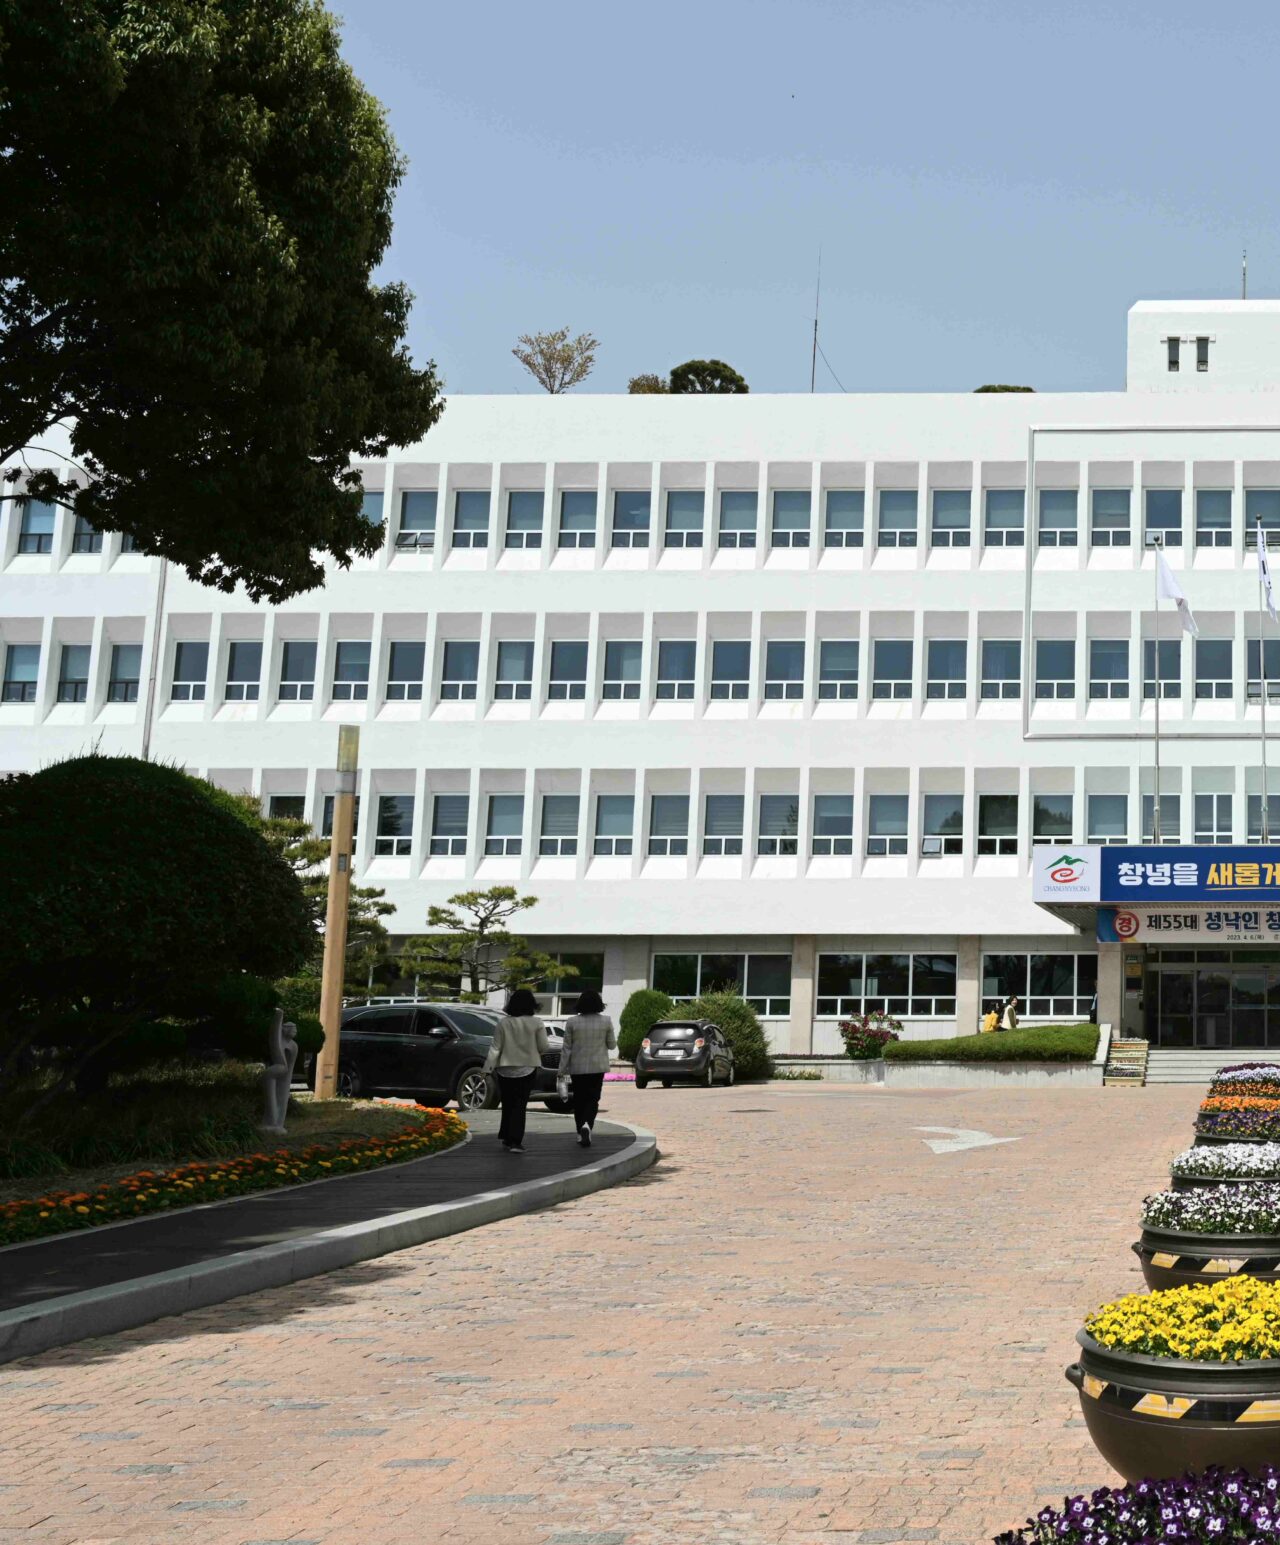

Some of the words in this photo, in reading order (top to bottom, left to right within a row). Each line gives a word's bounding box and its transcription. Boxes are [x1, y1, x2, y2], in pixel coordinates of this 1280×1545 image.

[1118, 862, 1199, 886] 창녕을
[1118, 917, 1133, 933] 경
[1146, 914, 1199, 930] 제55대
[1204, 911, 1260, 930] 성낙인
